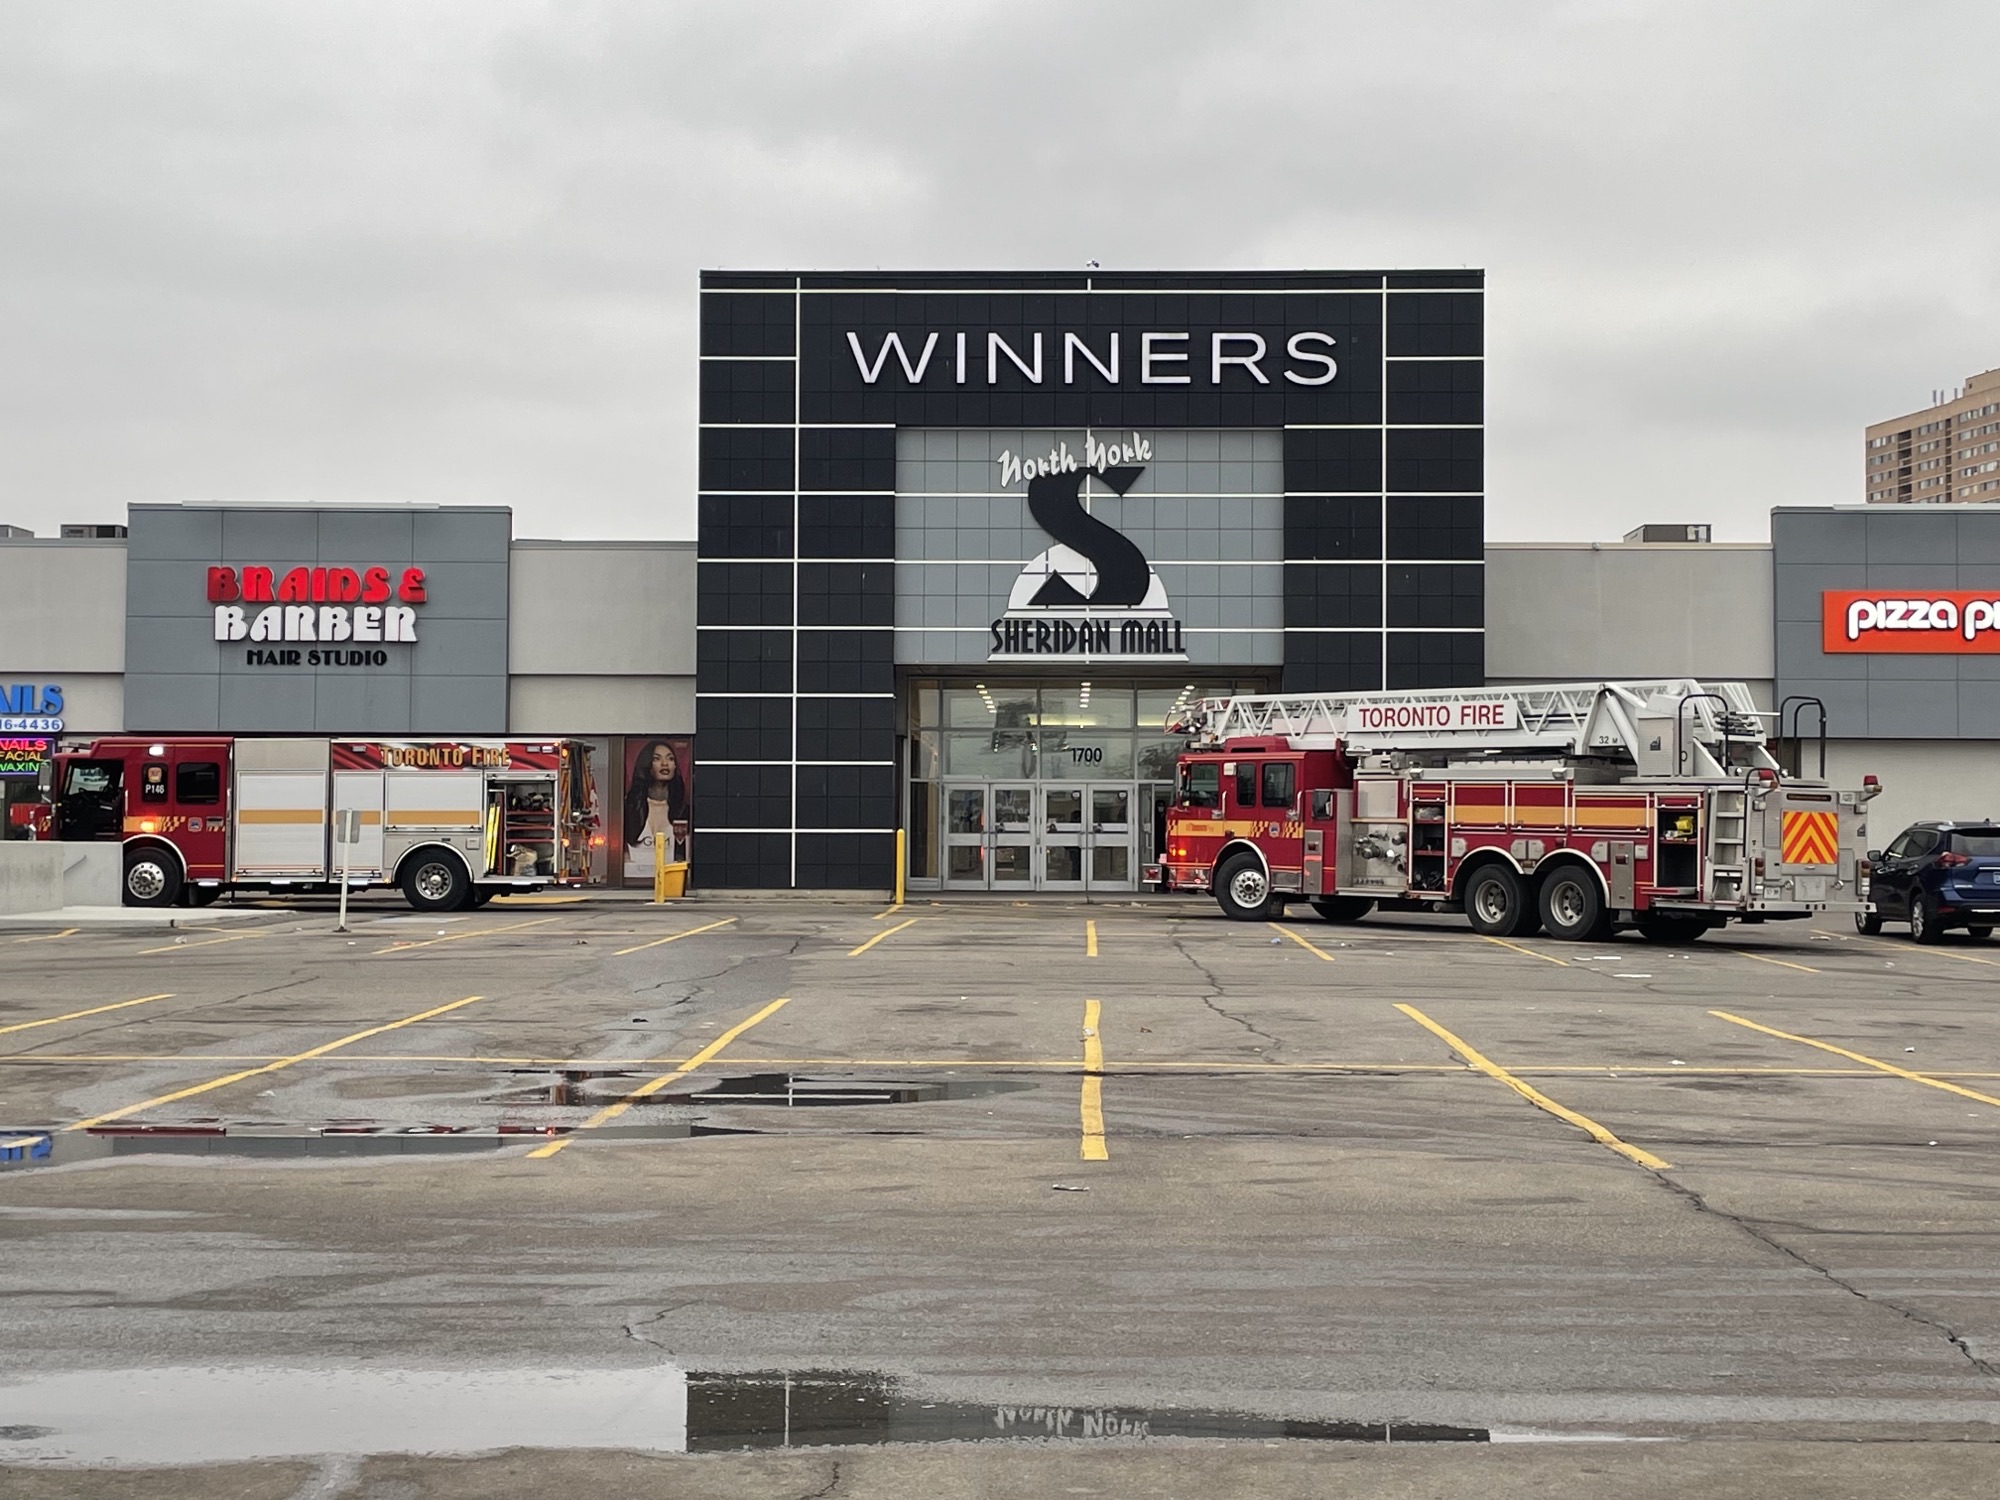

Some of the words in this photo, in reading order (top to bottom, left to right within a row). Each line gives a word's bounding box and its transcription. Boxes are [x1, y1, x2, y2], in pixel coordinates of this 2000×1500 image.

[846, 331, 1338, 386] WINNERS
[997, 442, 1078, 488] North
[1085, 432, 1153, 474] York
[207, 566, 392, 604] BRAIDS
[398, 567, 427, 604] &
[215, 605, 418, 642] BARBER
[991, 619, 1110, 654] SHERIDAN
[1121, 619, 1186, 654] MALL
[1846, 598, 1959, 642] pizza
[246, 649, 301, 666] HAIR
[308, 649, 388, 666] STUDIO
[1359, 705, 1451, 728] TORONTO
[1460, 703, 1505, 726] FIRE
[0, 762, 39, 772] WAXIN
[382, 746, 463, 766] TORONTO
[471, 746, 510, 766] FIRE
[1072, 747, 1102, 763] 1700
